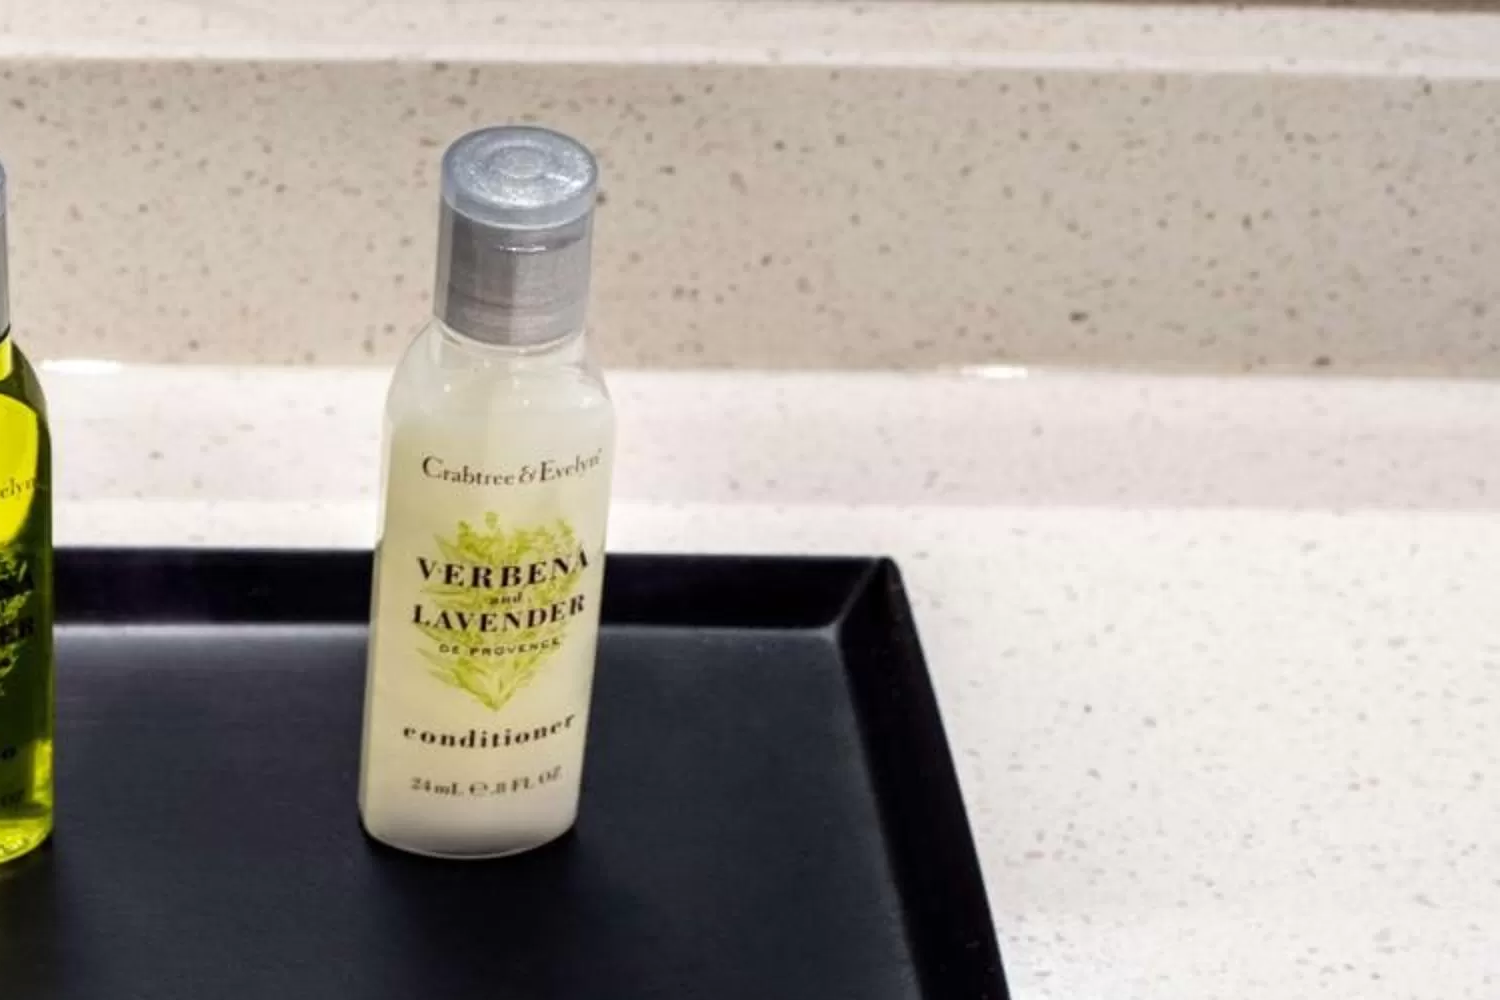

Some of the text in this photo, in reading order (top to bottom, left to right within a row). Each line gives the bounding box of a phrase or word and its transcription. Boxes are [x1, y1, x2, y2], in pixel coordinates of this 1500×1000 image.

[421, 455, 515, 486] Crabtree
[539, 452, 600, 483] Evelyn
[416, 549, 590, 589] VERBENA
[411, 593, 586, 633] LAVENDER
[488, 592, 523, 606] and
[439, 638, 562, 657] DE PROVENCE
[402, 713, 576, 750] conditioner
